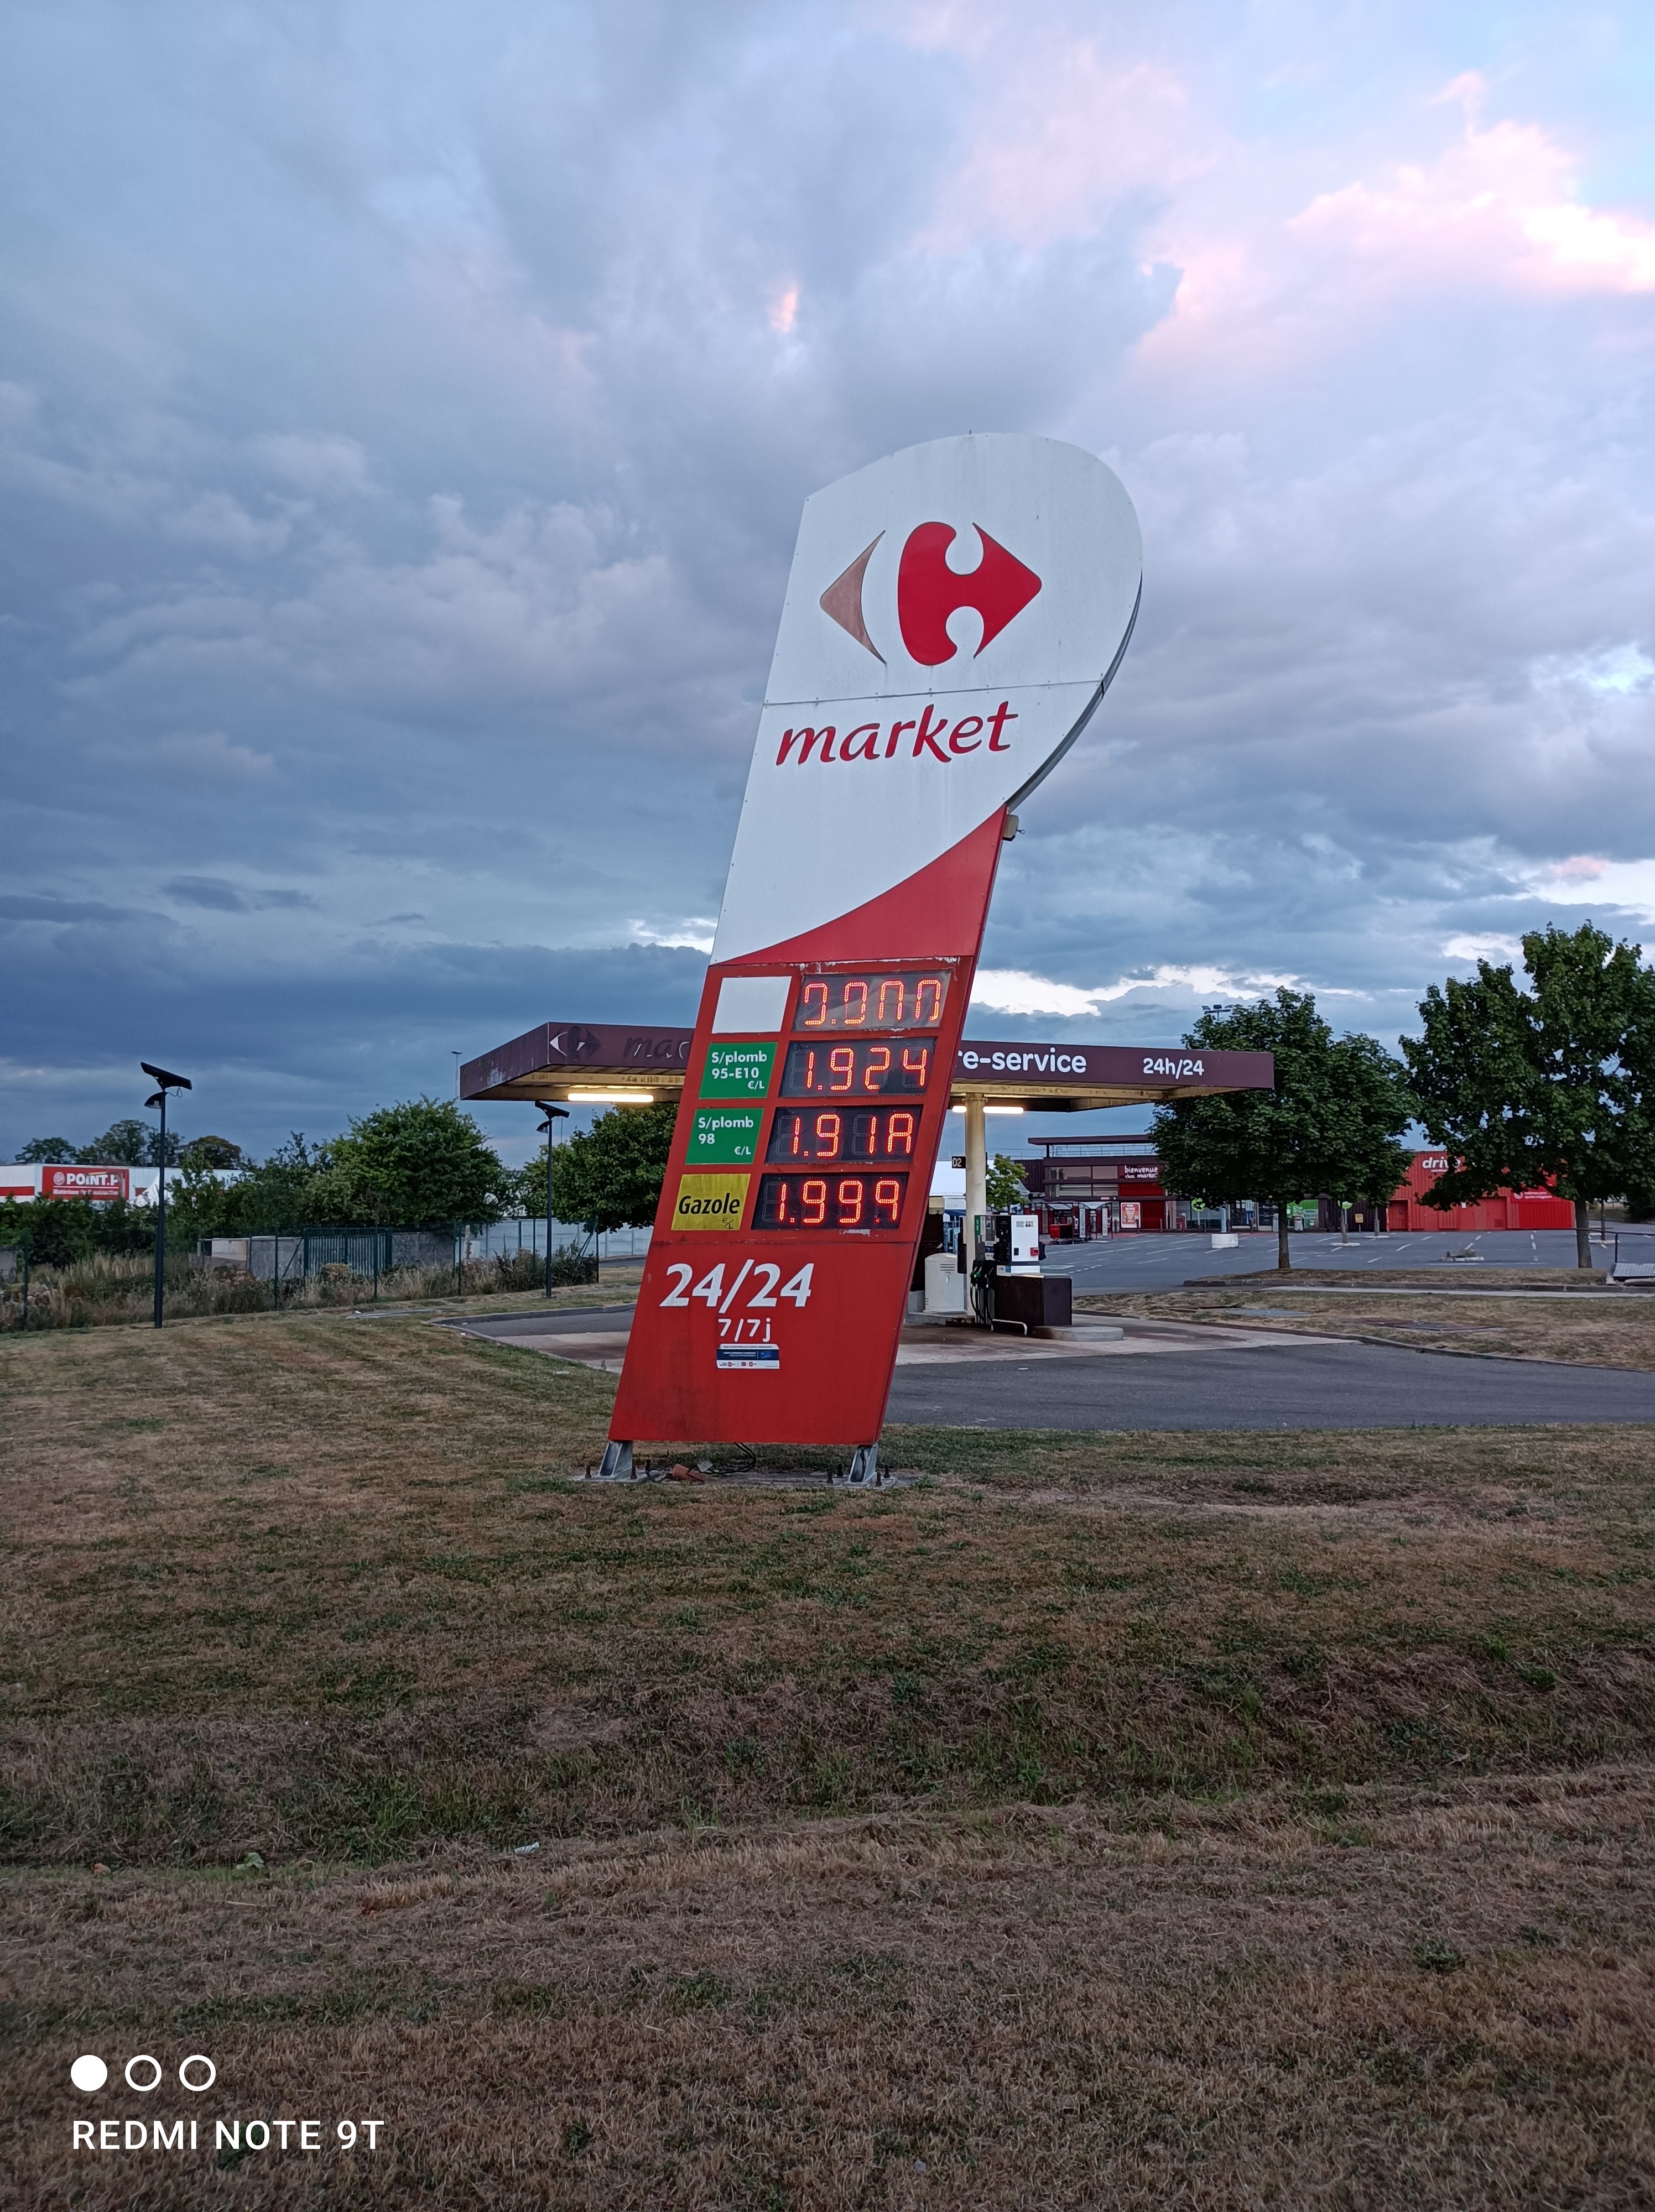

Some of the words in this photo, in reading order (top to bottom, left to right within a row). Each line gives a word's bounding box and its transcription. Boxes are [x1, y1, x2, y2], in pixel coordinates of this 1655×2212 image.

[776, 701, 1019, 766] market
[623, 1037, 690, 1060] mar
[711, 1050, 767, 1066] S/plomb
[711, 1067, 759, 1079] 95-E10
[806, 1047, 928, 1091] 1.924
[1143, 1057, 1205, 1079] 24h/24
[747, 1081, 764, 1090] €/L
[698, 1116, 754, 1131] S/plomb
[698, 1133, 715, 1144] 98
[734, 1146, 751, 1156] €/L
[953, 1157, 962, 1167] 02
[1124, 1165, 1158, 1173] bienvenue
[679, 1192, 740, 1214] Gazole
[779, 1180, 899, 1224] 1.999
[659, 1259, 815, 1314] 24/24
